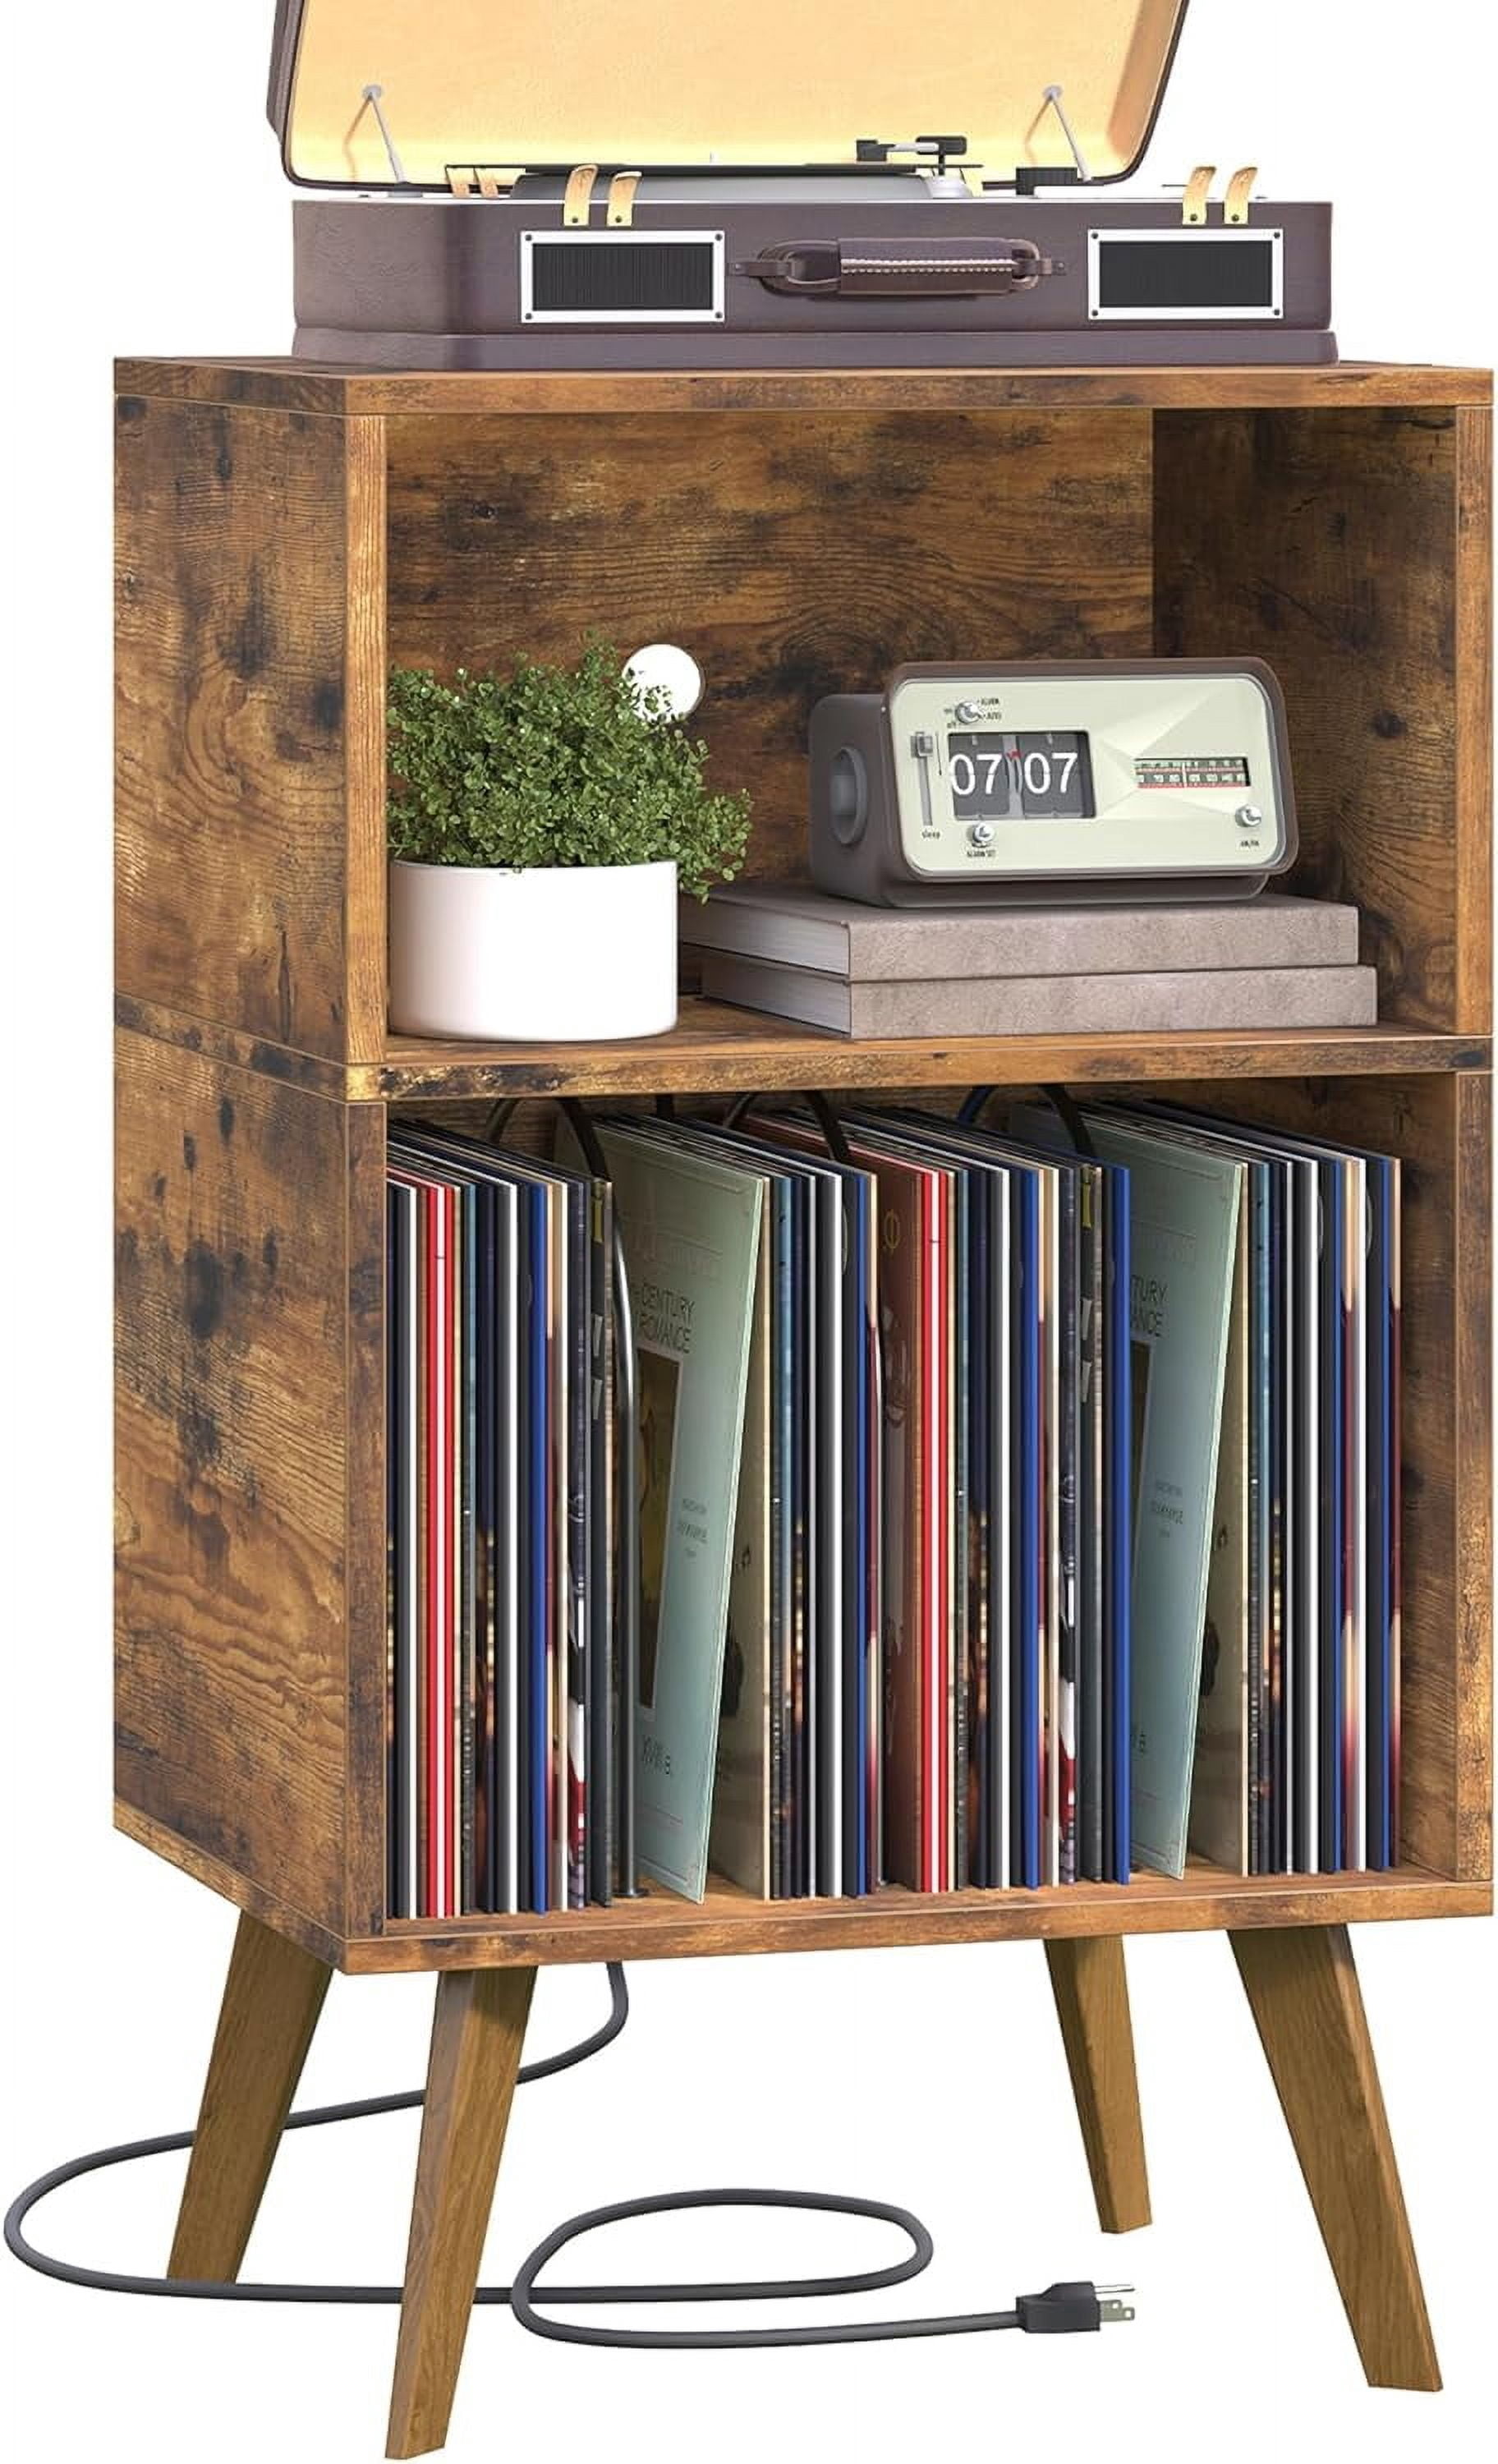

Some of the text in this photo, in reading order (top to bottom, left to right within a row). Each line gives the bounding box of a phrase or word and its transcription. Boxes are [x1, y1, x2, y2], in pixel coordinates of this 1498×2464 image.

[949, 752, 1078, 796] 07 07
[1130, 1274, 1169, 1304] TURY
[1130, 1304, 1164, 1338] ANCE
